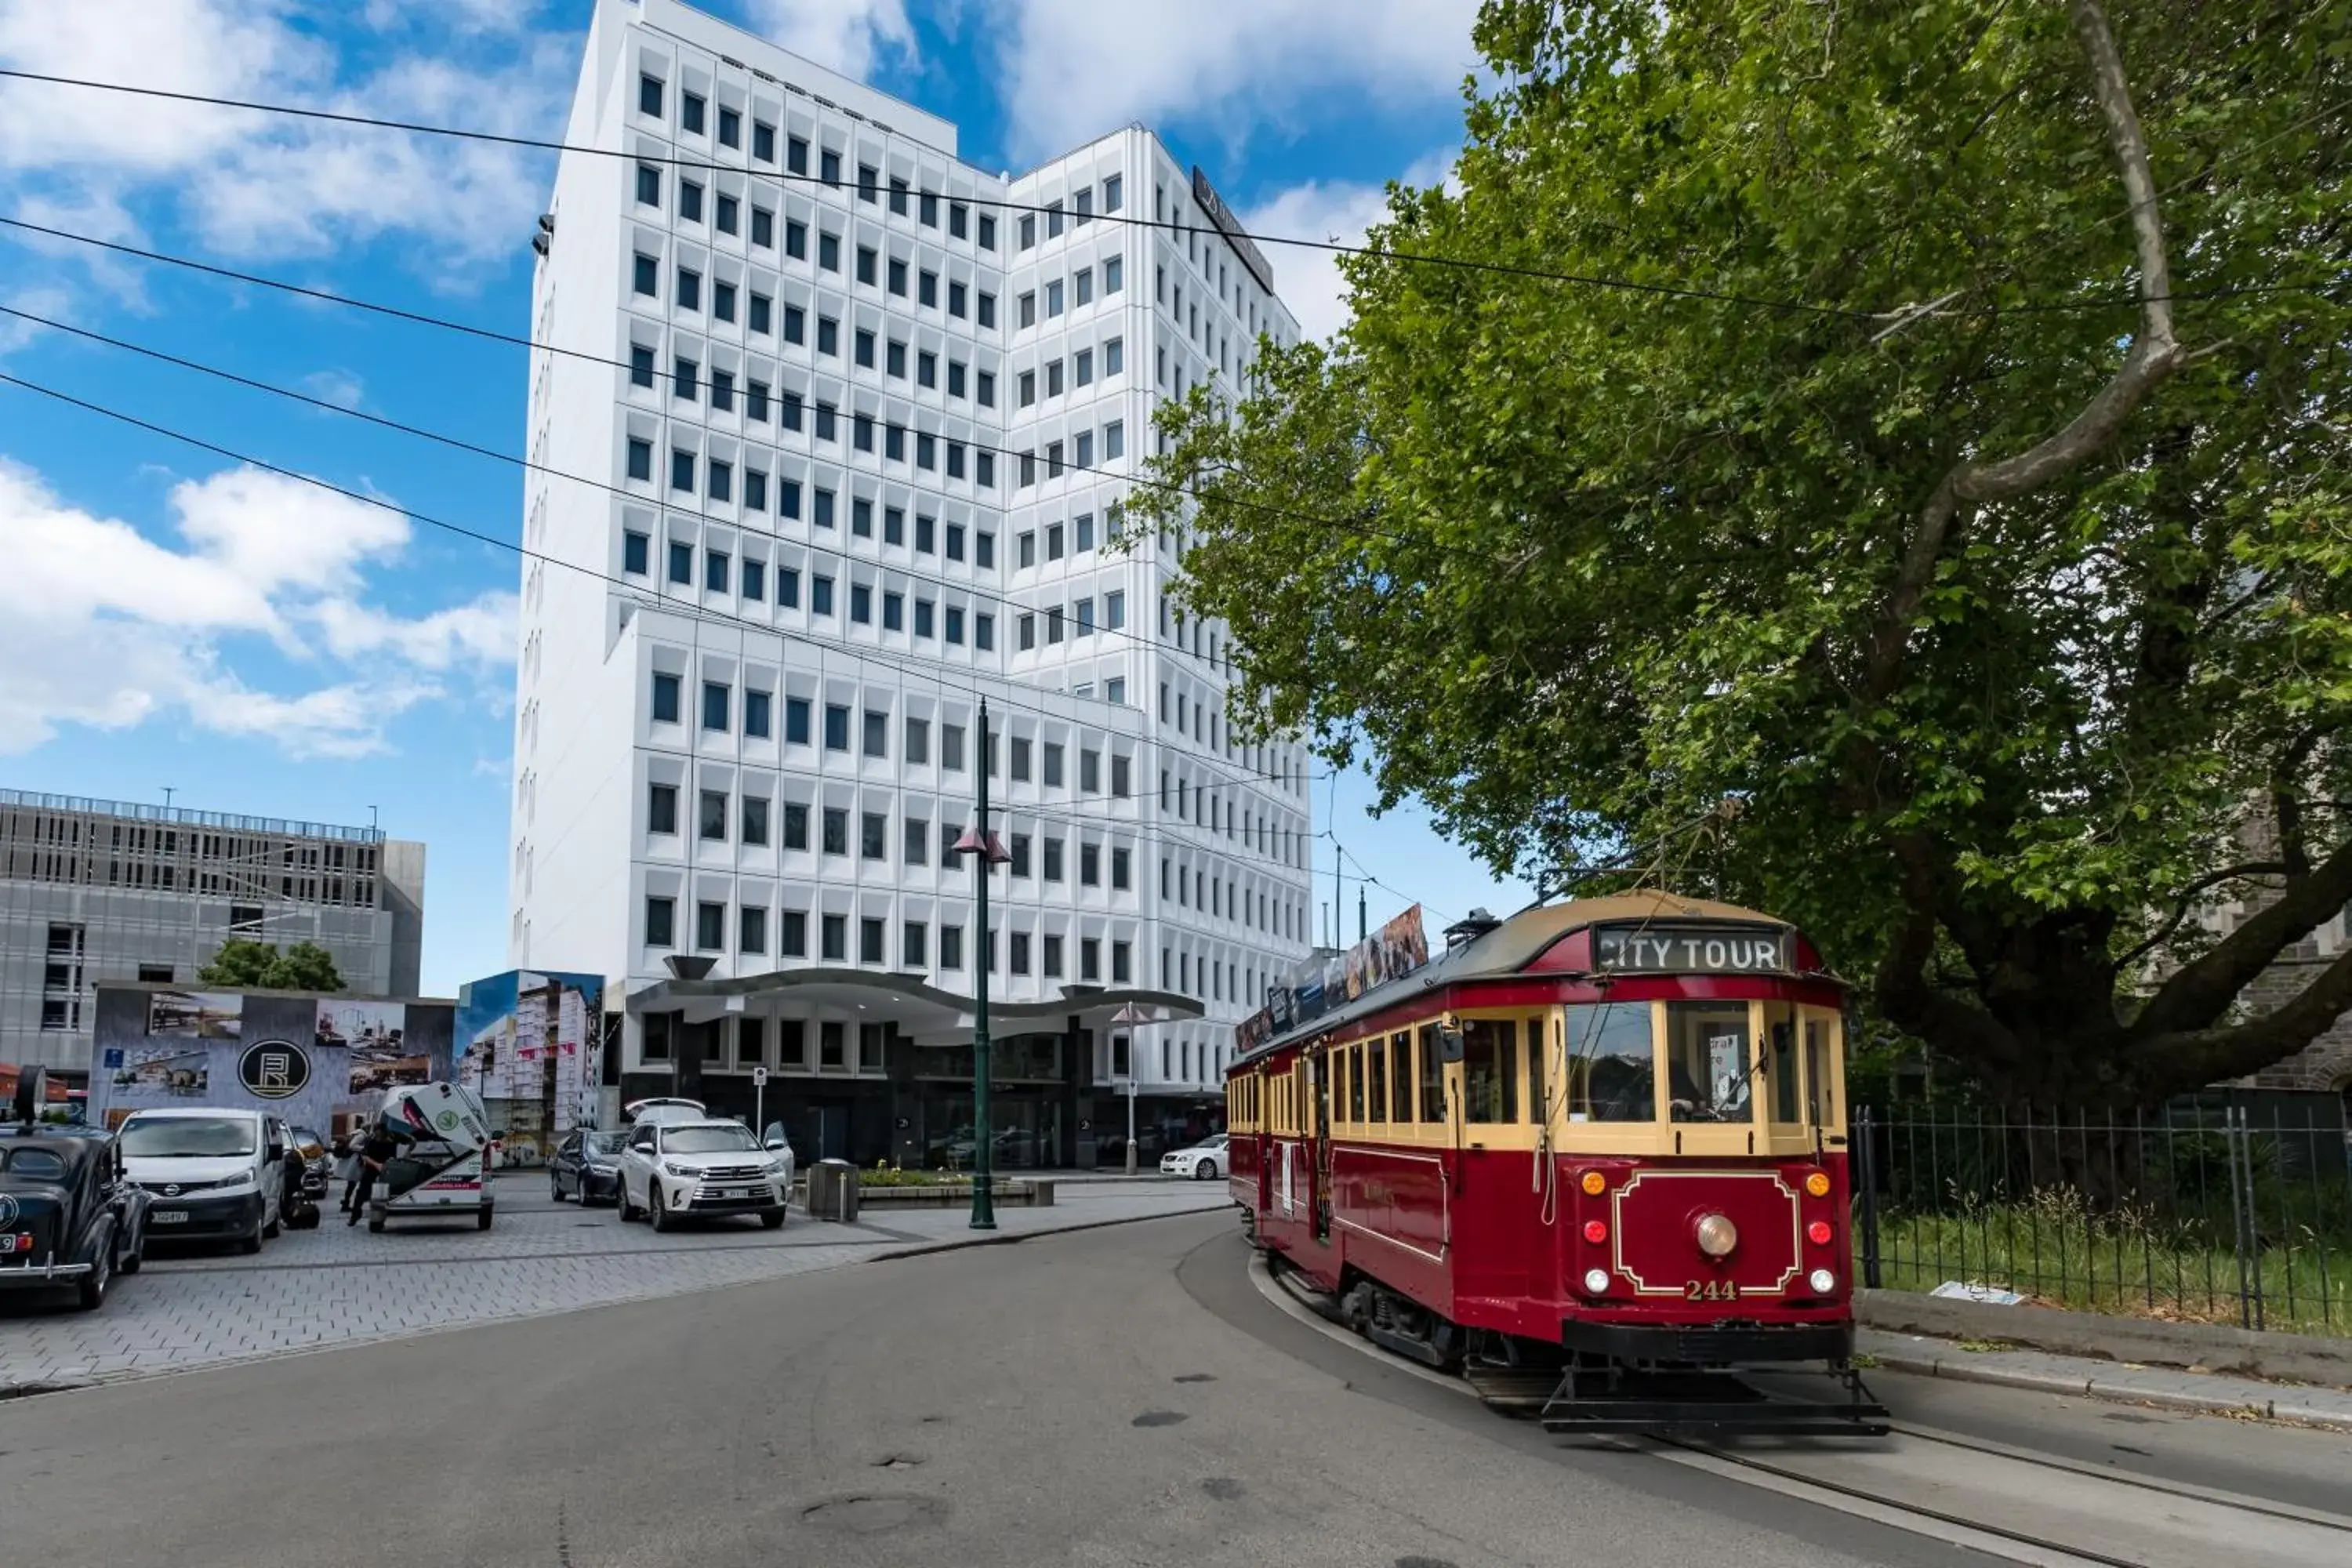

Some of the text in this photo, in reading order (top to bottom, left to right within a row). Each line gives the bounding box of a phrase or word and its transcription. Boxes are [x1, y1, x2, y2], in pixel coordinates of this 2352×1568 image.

[1601, 938, 1776, 969] CITY TOUR
[1686, 1279, 1737, 1301] 244
